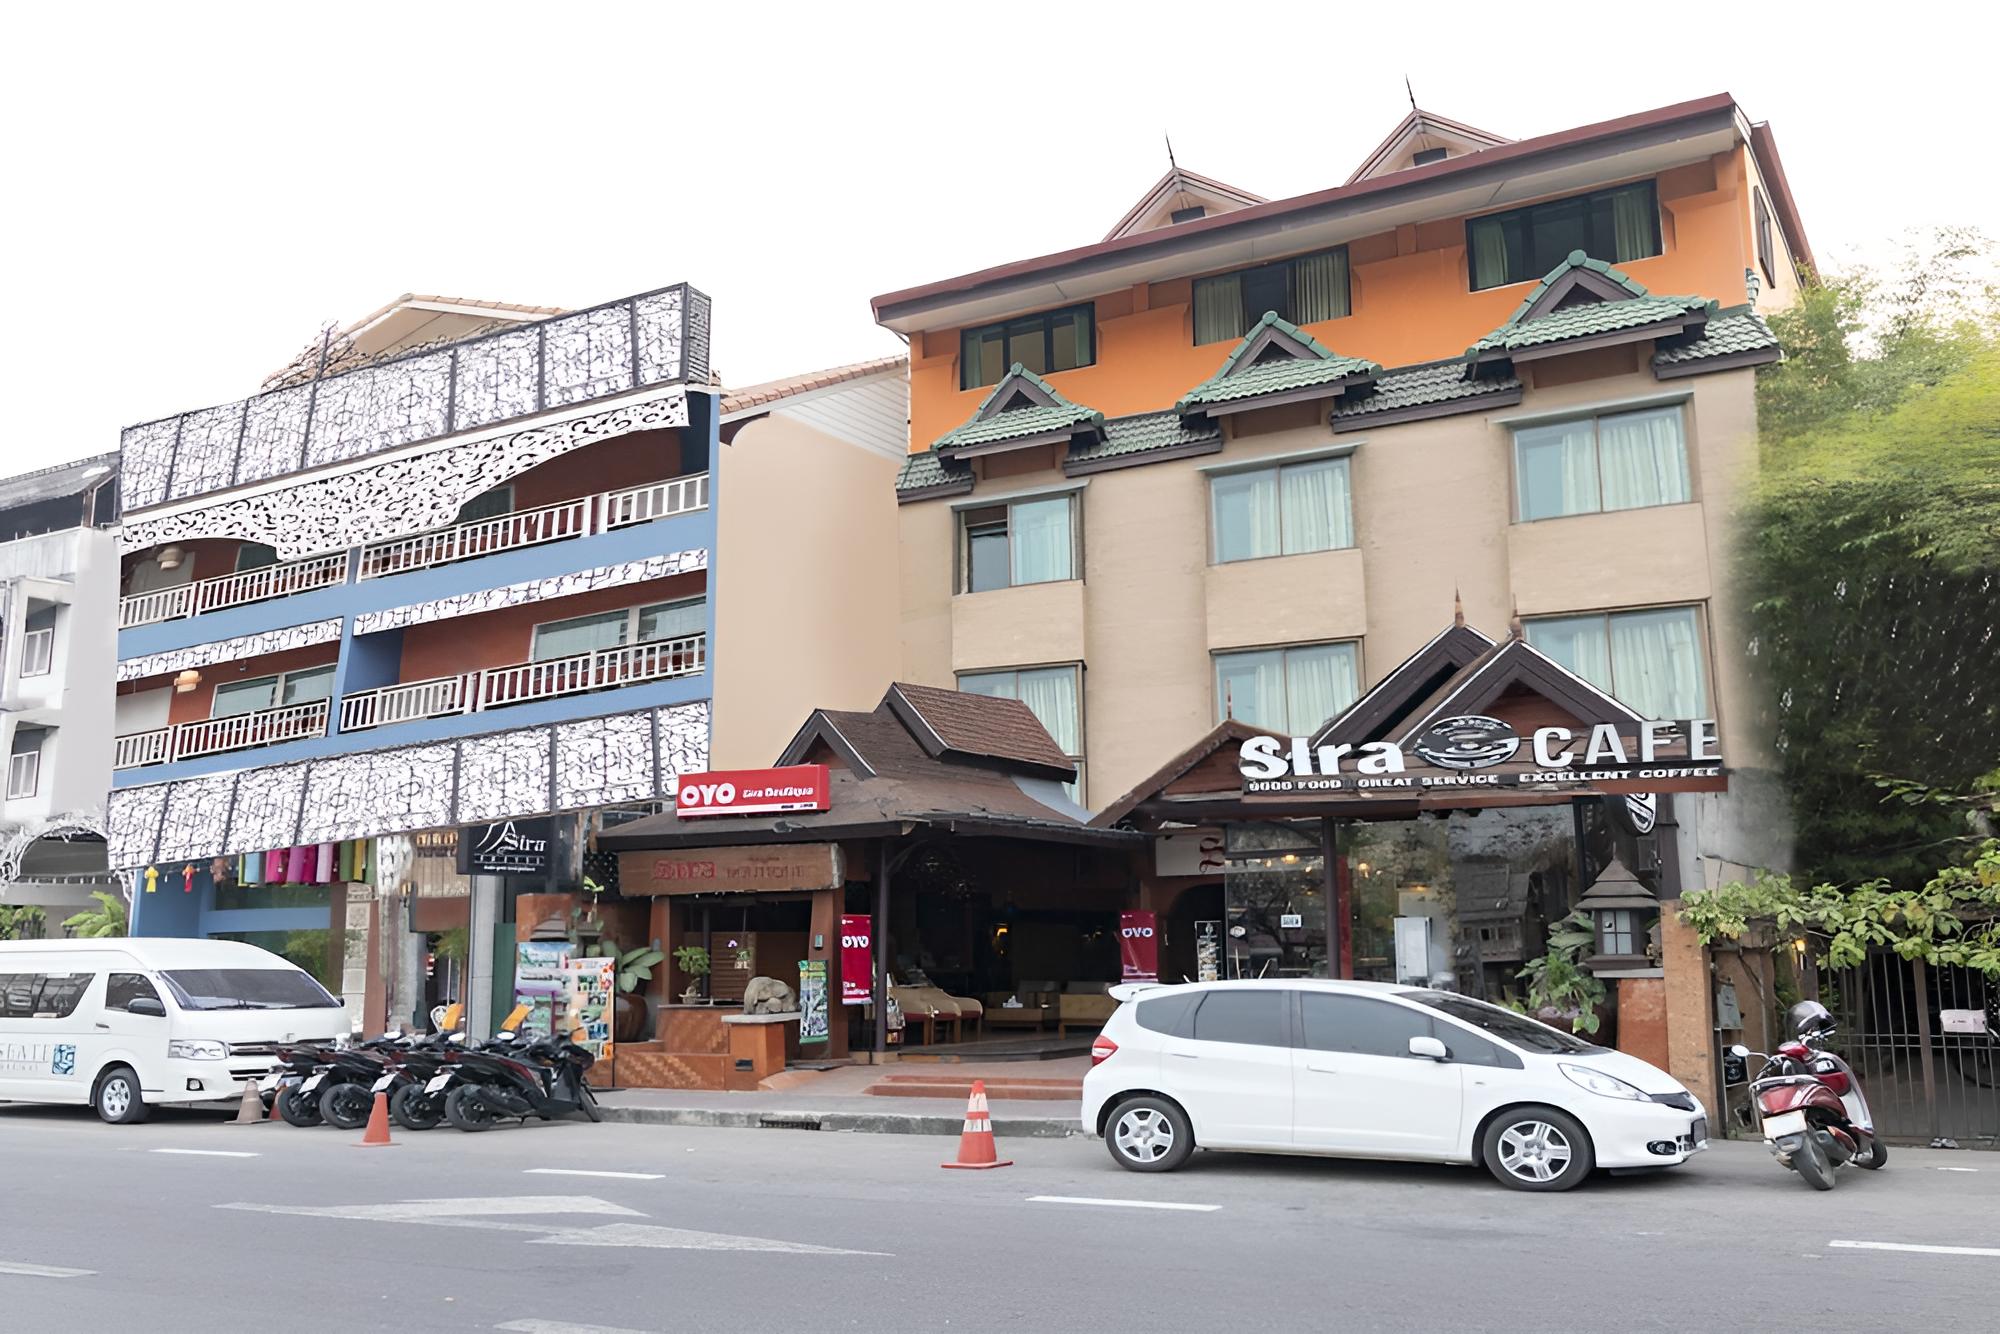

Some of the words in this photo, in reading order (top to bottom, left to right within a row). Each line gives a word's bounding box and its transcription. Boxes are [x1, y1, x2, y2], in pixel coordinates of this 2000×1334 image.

[1533, 719, 1722, 768] CAFE
[1298, 779, 1342, 790] FOOD
[1421, 774, 1498, 786] SERVICE
[1519, 769, 1631, 782] EXCELLENT
[1639, 767, 1720, 778] COFFEE
[680, 782, 736, 806] OYO
